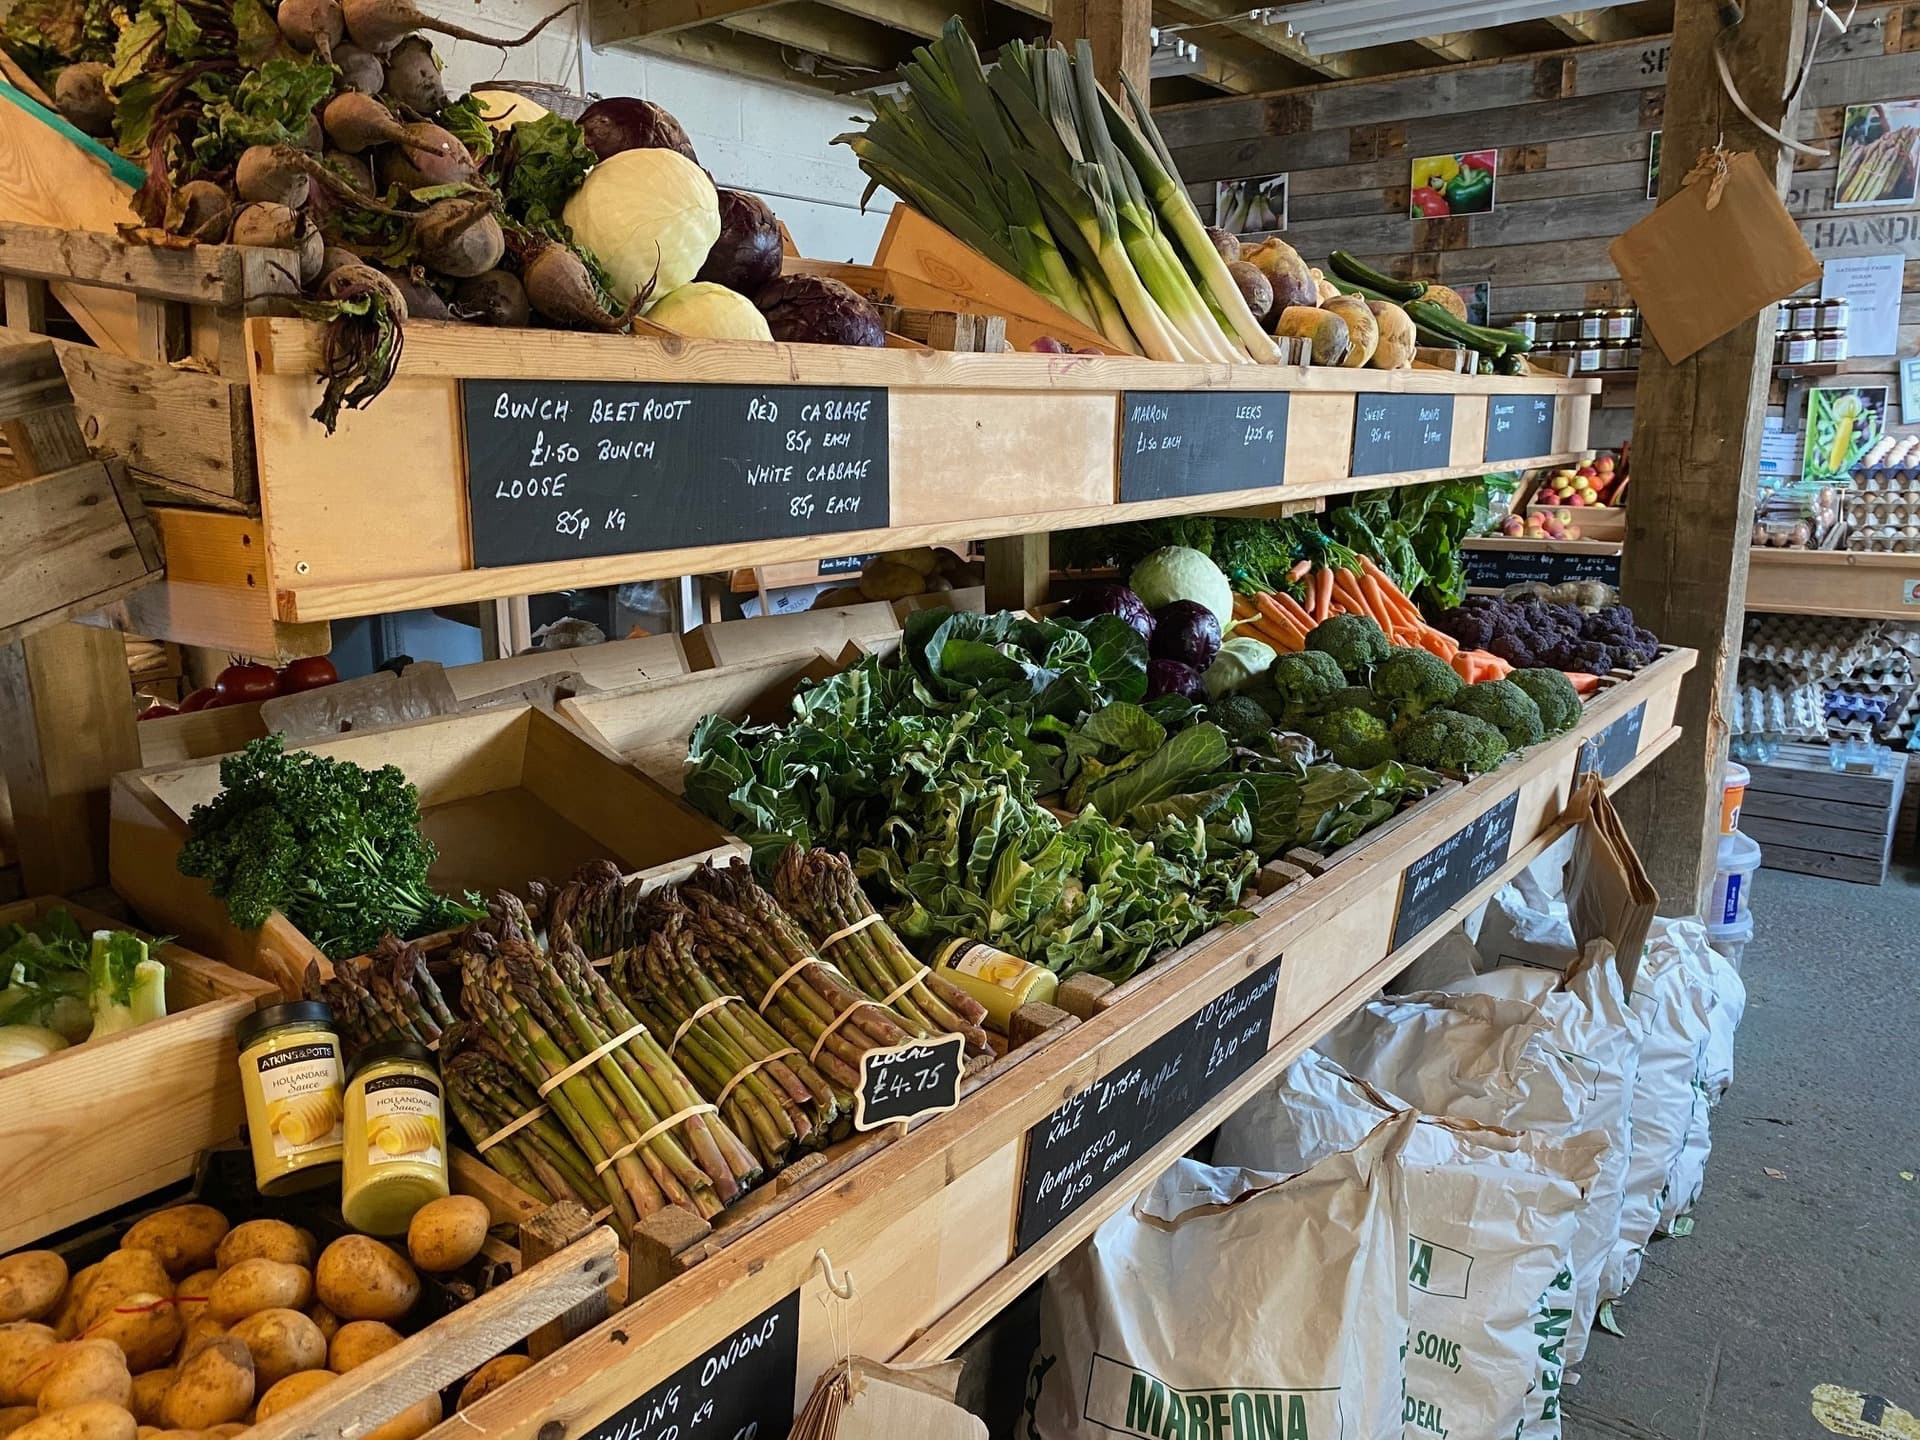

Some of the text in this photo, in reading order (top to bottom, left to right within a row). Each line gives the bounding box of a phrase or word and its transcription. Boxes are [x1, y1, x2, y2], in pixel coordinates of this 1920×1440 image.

[494, 393, 569, 423] BUNCH
[746, 397, 871, 423] RED CABBAGE
[1130, 404, 1169, 425] MARROW
[1235, 405, 1263, 420] LEEKS
[529, 430, 656, 467] £1.50 BUNCH
[785, 429, 851, 454] 85p EACH
[1161, 435, 1183, 450] EACH
[806, 459, 871, 482] CABBAGE
[495, 472, 568, 499] LOOSE
[790, 494, 861, 519] 85p EACH
[555, 507, 591, 540] 85p
[1194, 988, 1237, 1031] LOCAL
[870, 1046, 935, 1068] LOCAL
[272, 1070, 330, 1089] HOLLANDAISE
[287, 1082, 320, 1094] Sauce
[870, 1062, 946, 1104] £4.75
[376, 1096, 432, 1108] HOLLANDAISE
[390, 1103, 422, 1112] Sauce
[1045, 1104, 1085, 1149] KALE
[1036, 1129, 1116, 1203] ROMANESCO
[1102, 1140, 1132, 1173] EACH
[700, 1313, 780, 1388] ONIONS
[1414, 1329, 1463, 1375] SONS,
[690, 1399, 714, 1429] KG
[1124, 1372, 1310, 1440] MARFONA
